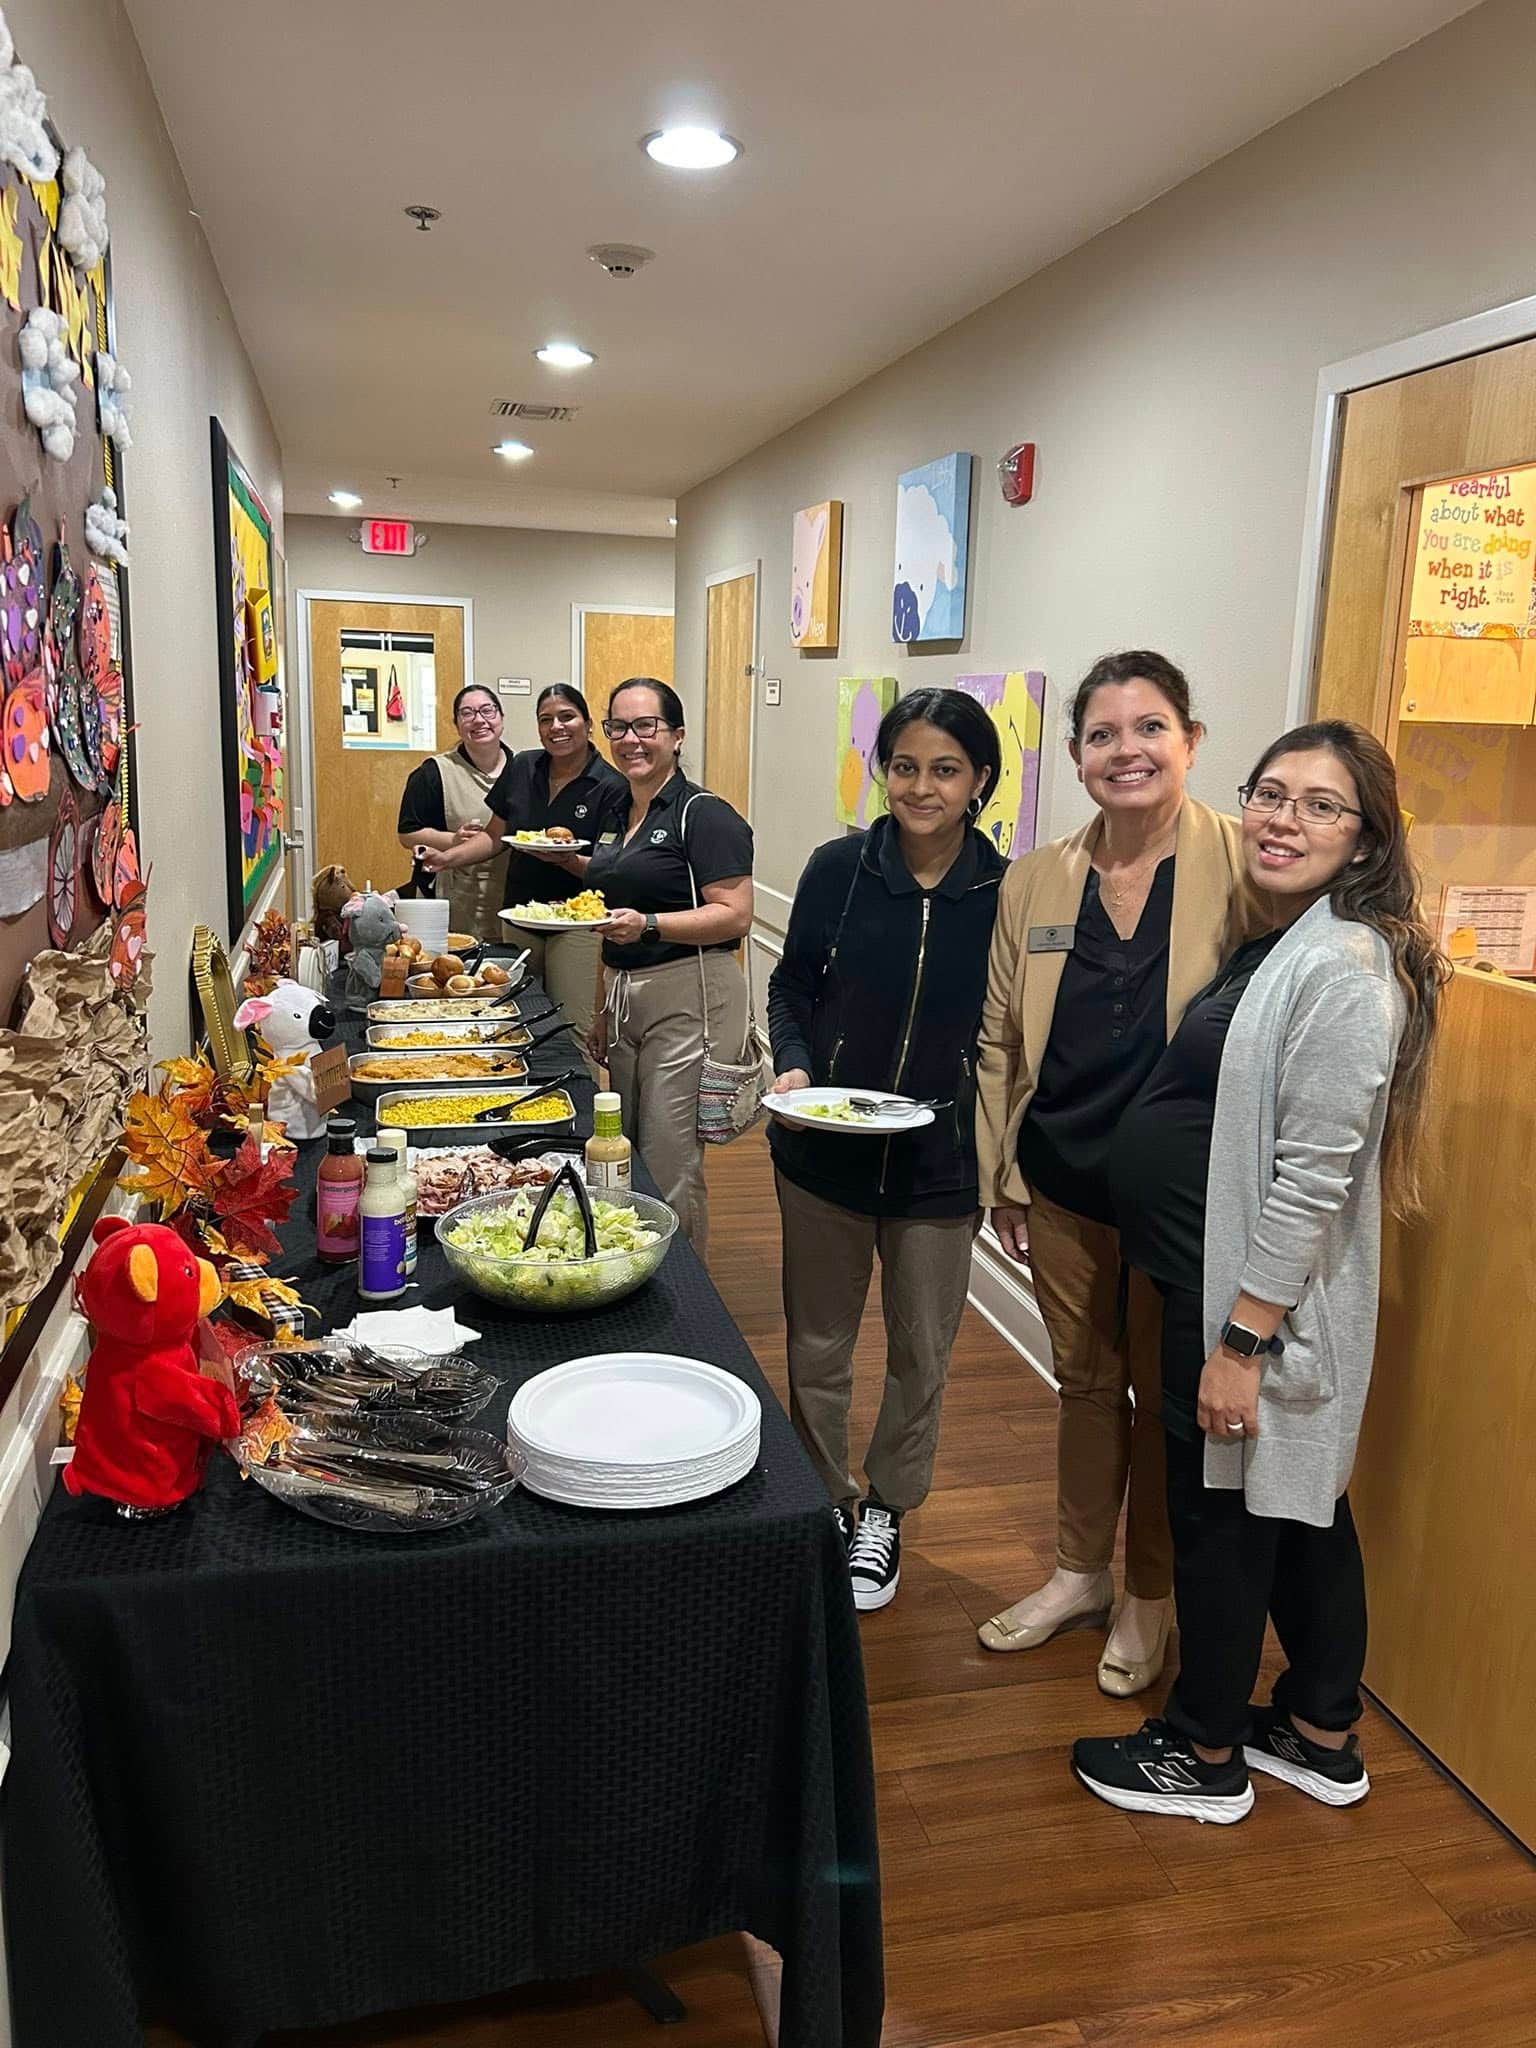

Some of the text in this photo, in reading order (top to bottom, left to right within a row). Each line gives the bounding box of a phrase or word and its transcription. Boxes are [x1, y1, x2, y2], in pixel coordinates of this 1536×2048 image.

[1430, 499, 1525, 527] about what
[371, 521, 407, 551] EXIT
[1453, 532, 1481, 554] are
[1483, 529, 1533, 560] doing
[1427, 557, 1474, 579] when
[1478, 559, 1493, 580] it
[1440, 582, 1490, 611] right.
